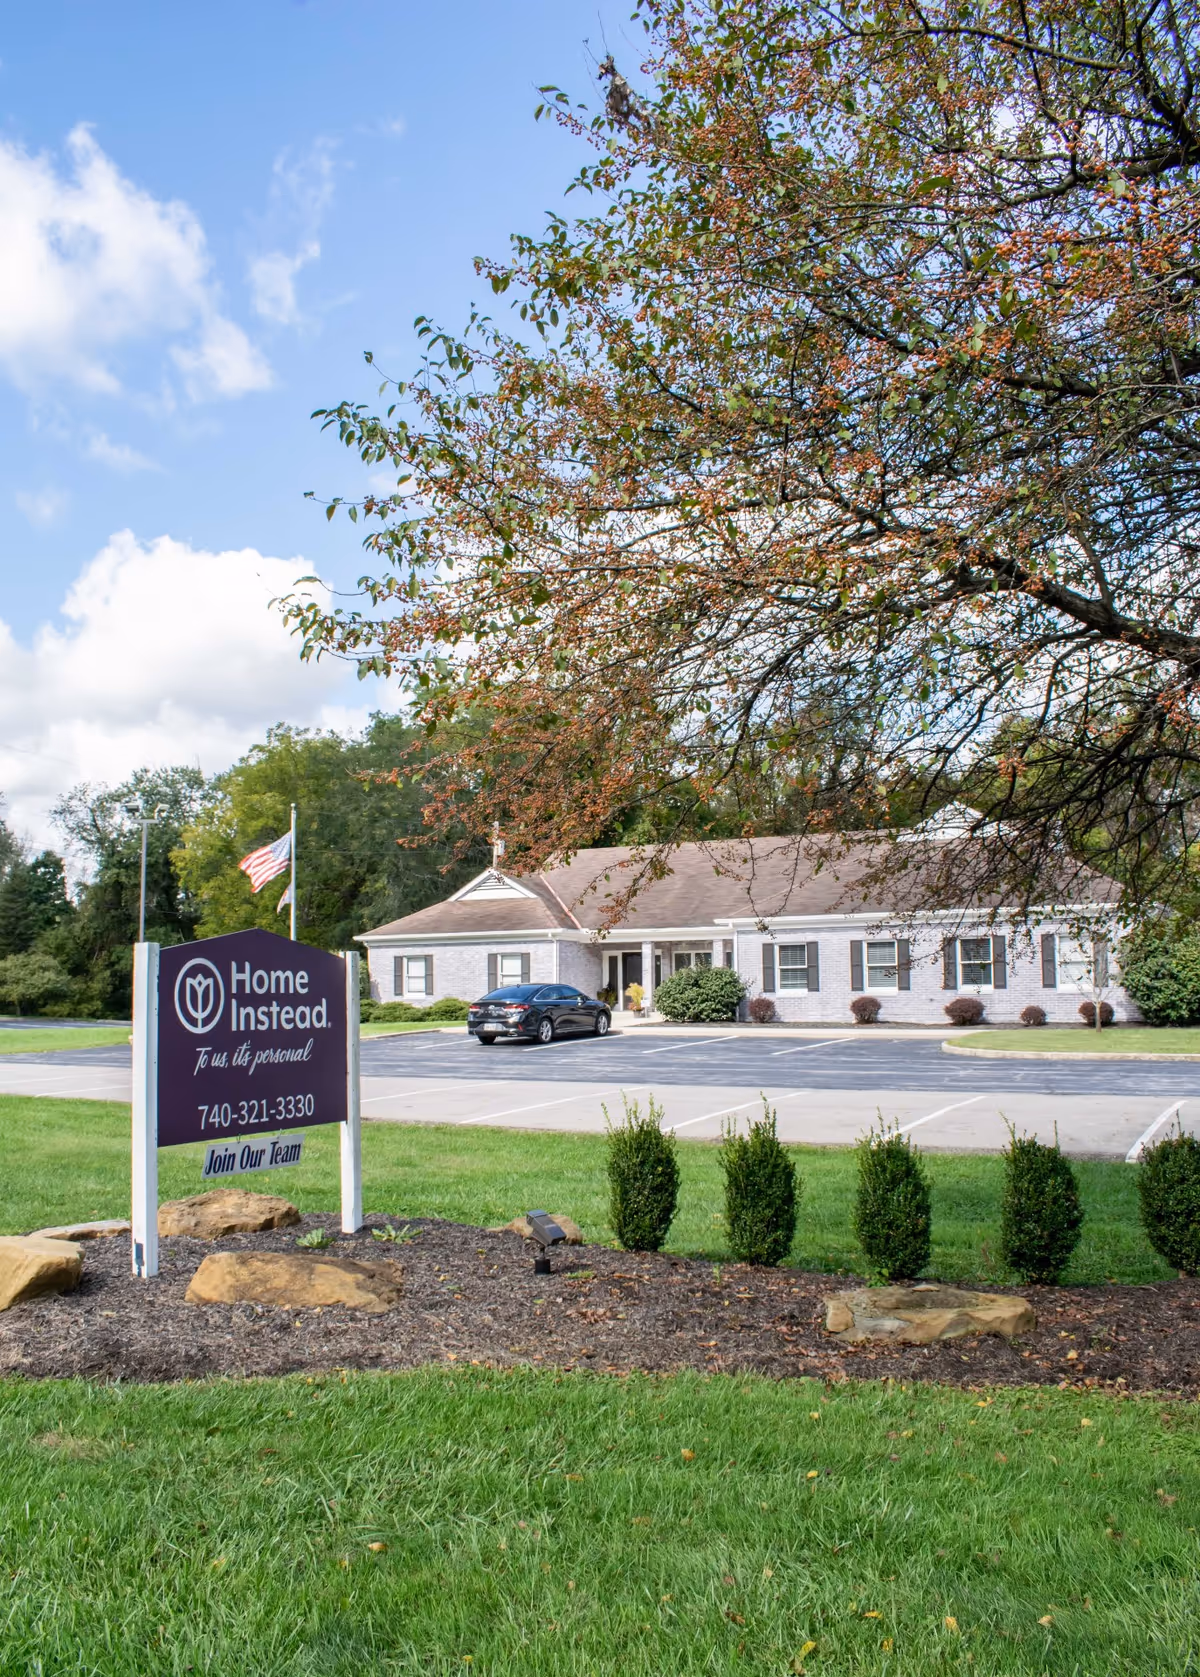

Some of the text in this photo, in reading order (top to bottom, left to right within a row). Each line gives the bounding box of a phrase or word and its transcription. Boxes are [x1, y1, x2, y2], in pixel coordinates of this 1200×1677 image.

[231, 960, 309, 994] Home
[193, 1038, 314, 1076] To us, it's personal
[198, 1094, 314, 1130] 740-321-3330
[204, 1141, 302, 1175] Join Our Team
